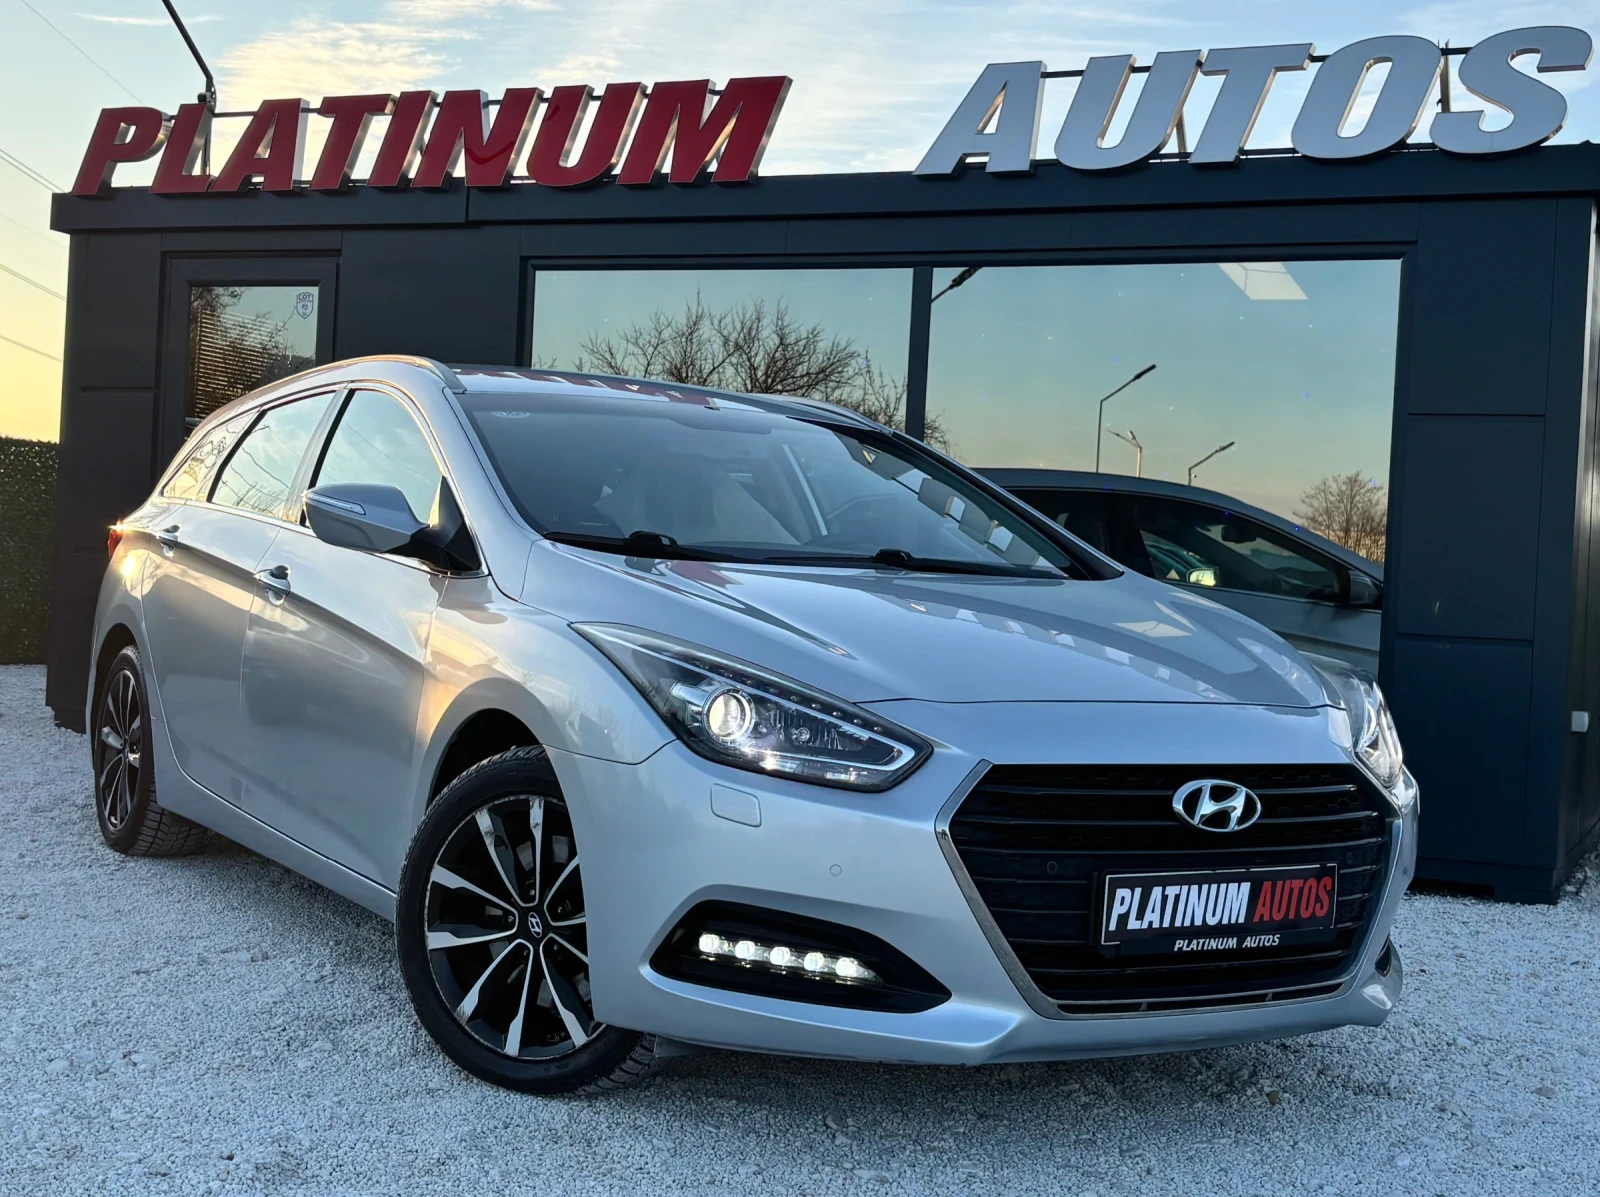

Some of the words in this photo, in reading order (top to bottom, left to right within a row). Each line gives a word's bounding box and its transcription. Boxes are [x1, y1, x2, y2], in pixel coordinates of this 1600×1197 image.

[71, 75, 793, 197] PLATINUM
[912, 25, 1594, 179] AUTOS
[1108, 881, 1251, 931] PLATINUM
[1253, 876, 1333, 923] AUTOS
[1173, 936, 1238, 952] PLATINUM
[1241, 934, 1281, 949] AUTOS
